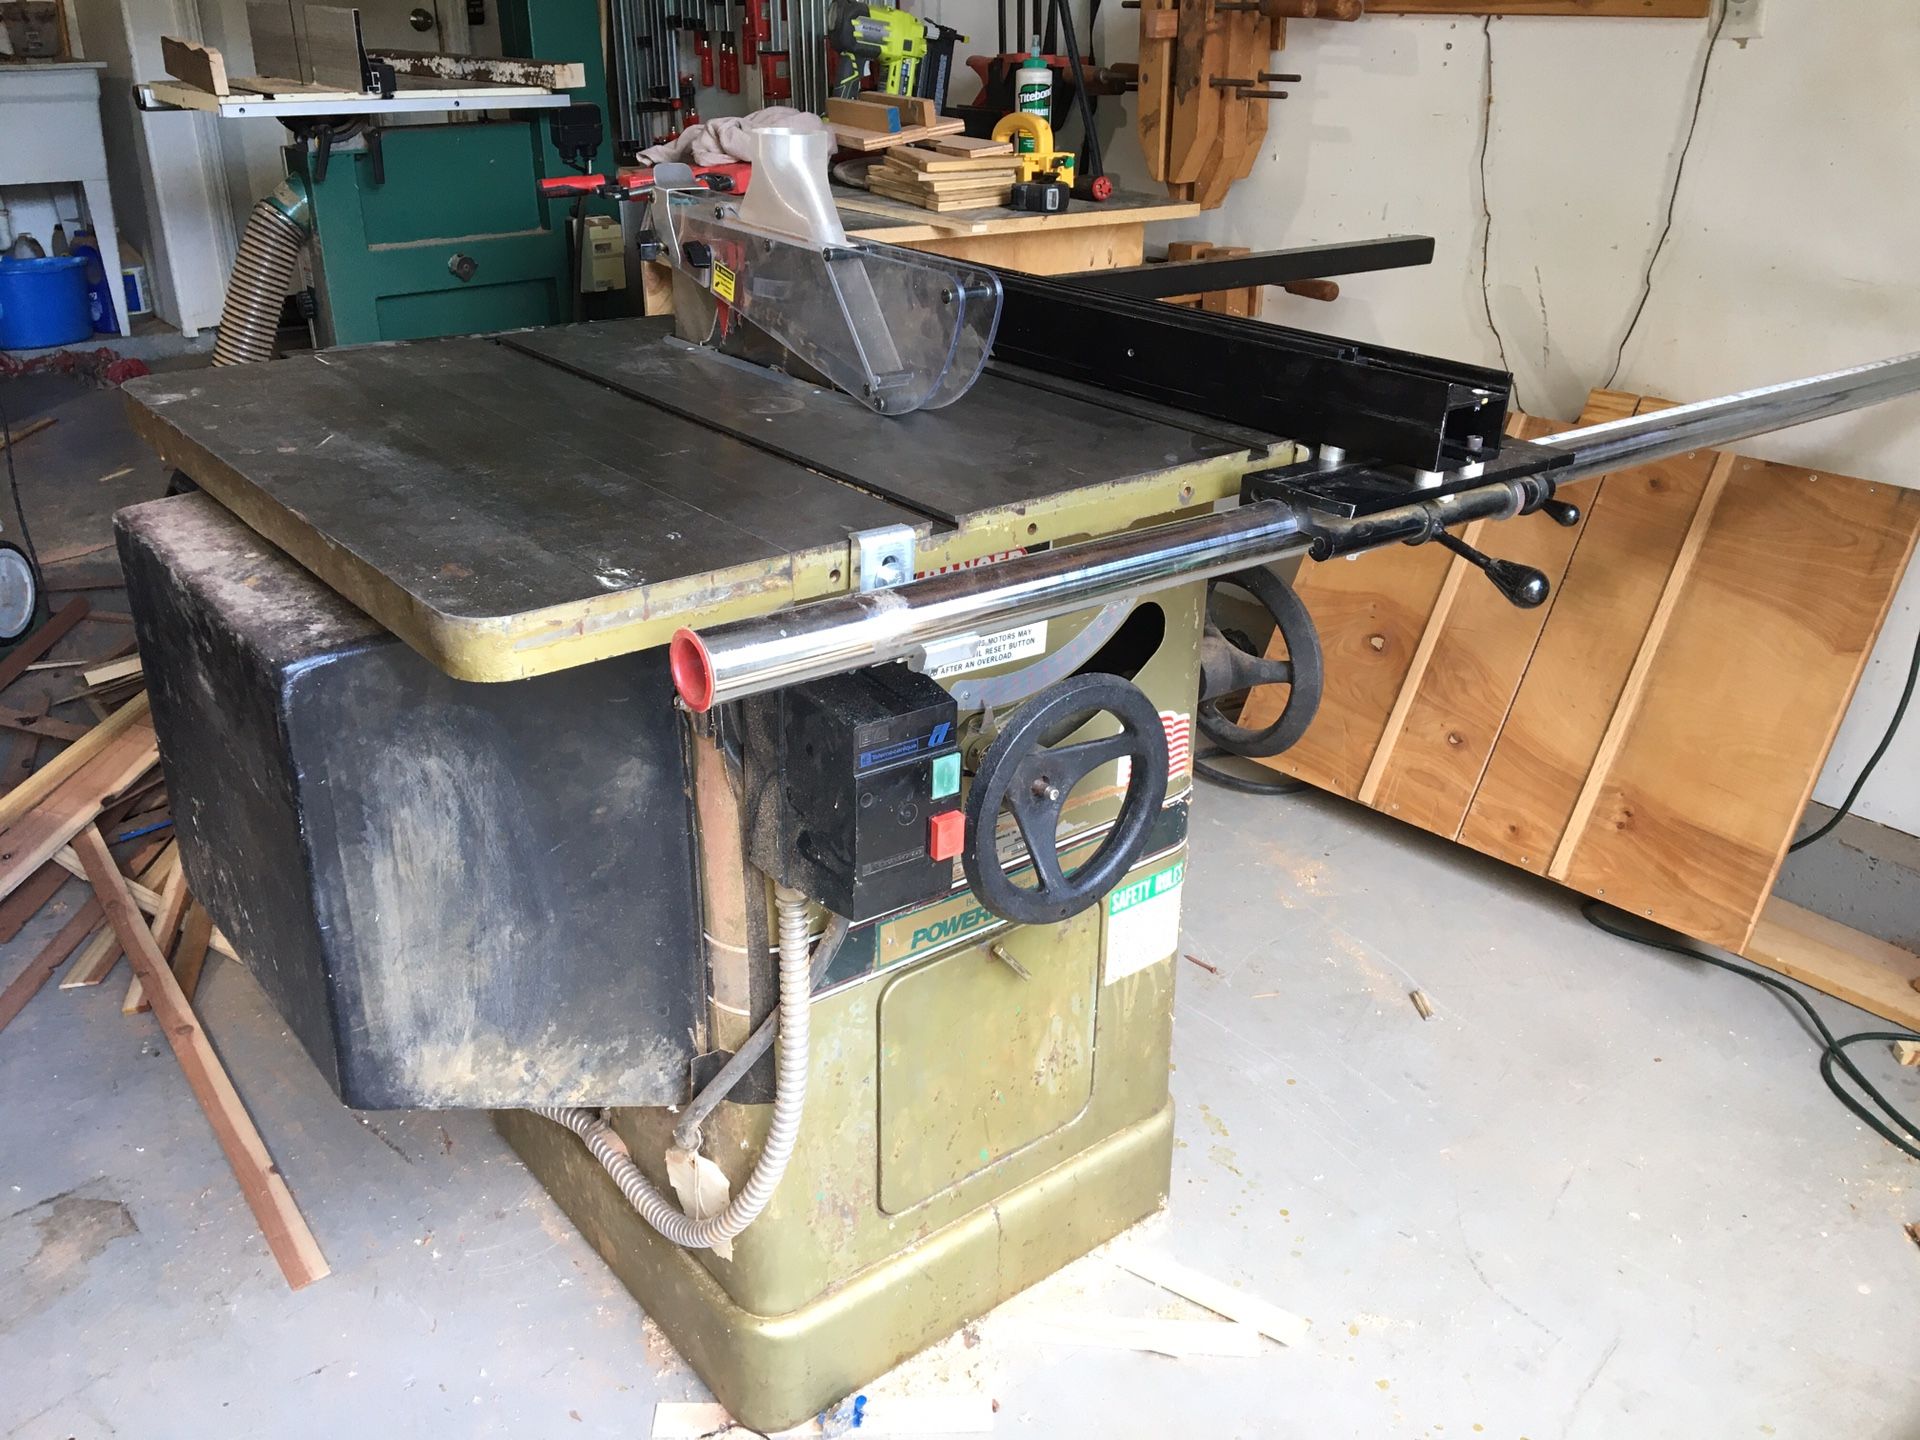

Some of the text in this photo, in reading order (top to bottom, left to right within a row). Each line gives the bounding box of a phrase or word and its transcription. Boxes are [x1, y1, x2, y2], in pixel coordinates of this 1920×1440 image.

[988, 633, 1015, 644] MOTORS
[1017, 628, 1033, 638] MAY
[984, 644, 1006, 655] RESET
[1008, 637, 1035, 649] BUTTON
[940, 664, 963, 675] AFTER
[965, 661, 975, 669] AN
[1111, 879, 1153, 914] SAFETY
